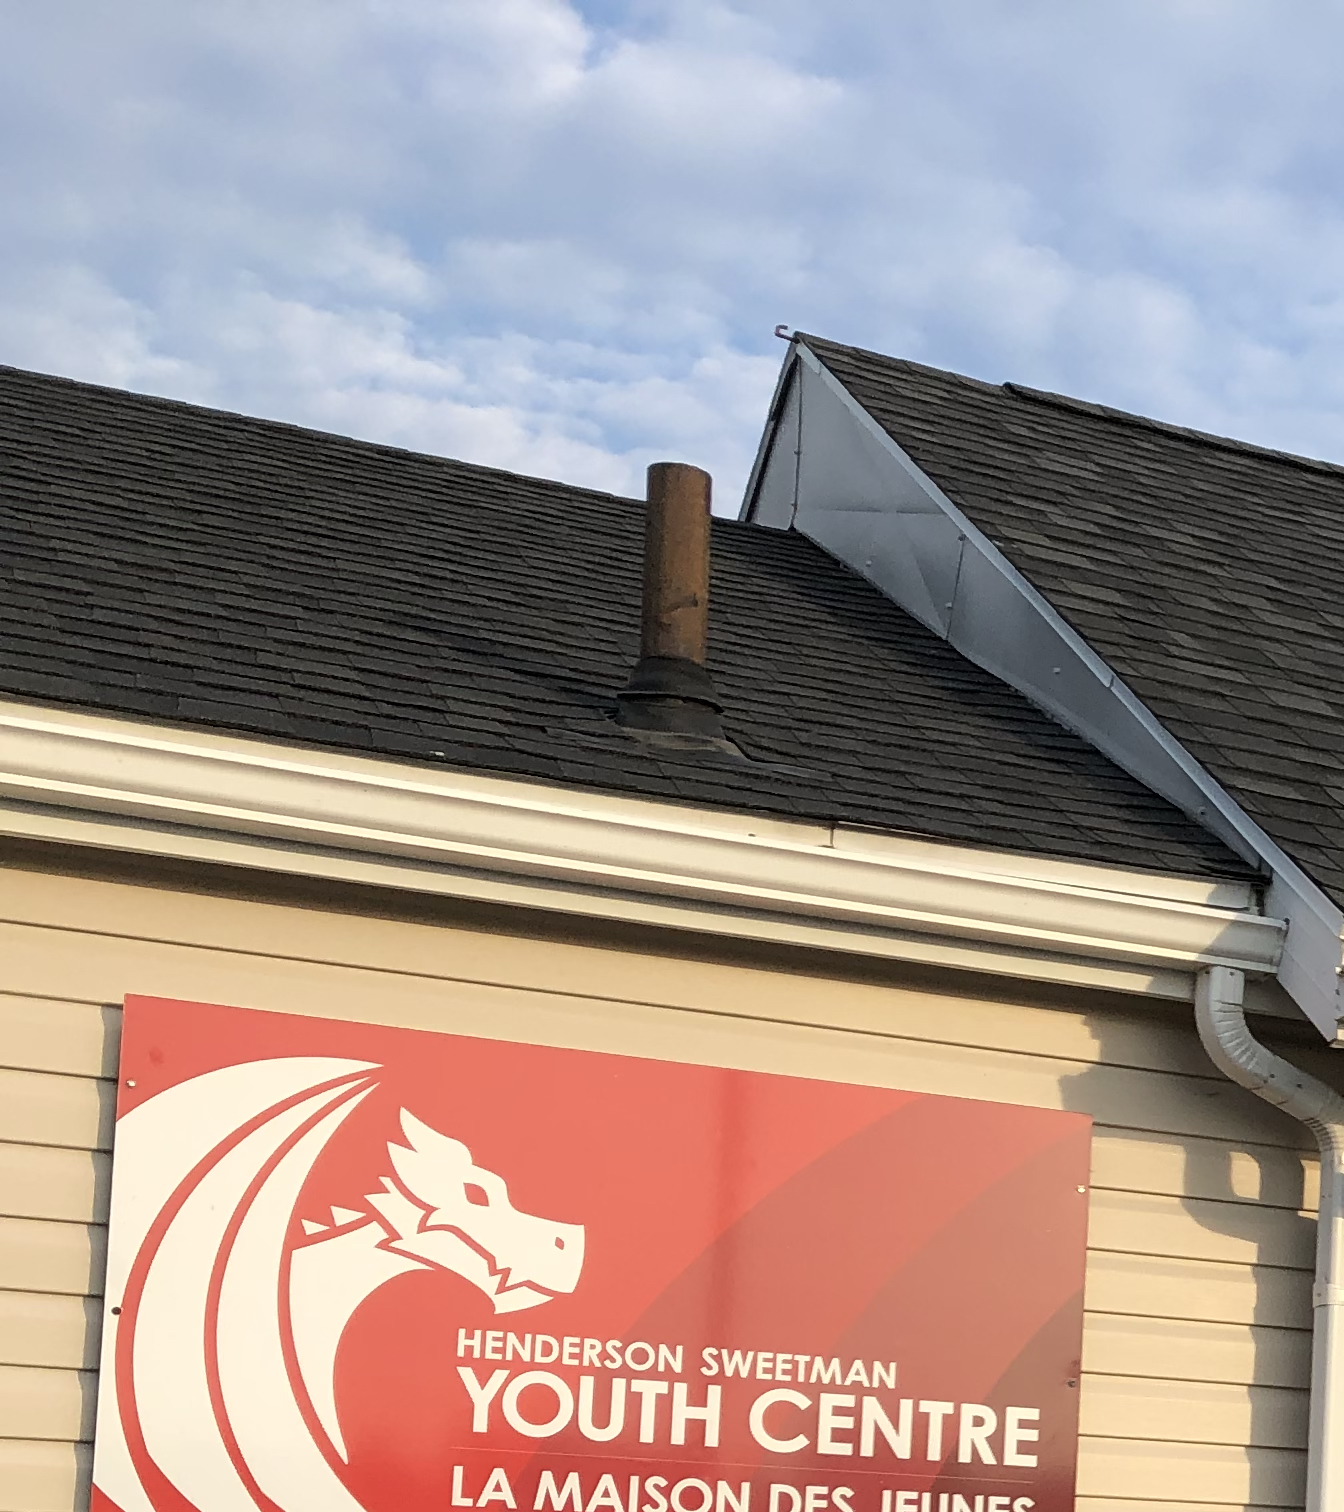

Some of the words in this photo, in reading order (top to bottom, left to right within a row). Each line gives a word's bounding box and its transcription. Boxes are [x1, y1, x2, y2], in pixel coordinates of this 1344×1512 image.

[456, 1327, 684, 1374] HENDERSON
[699, 1346, 897, 1389] SWEETMAN
[456, 1366, 722, 1448] YOUTH
[749, 1388, 1041, 1468] CENTRE
[451, 1465, 517, 1510] LA
